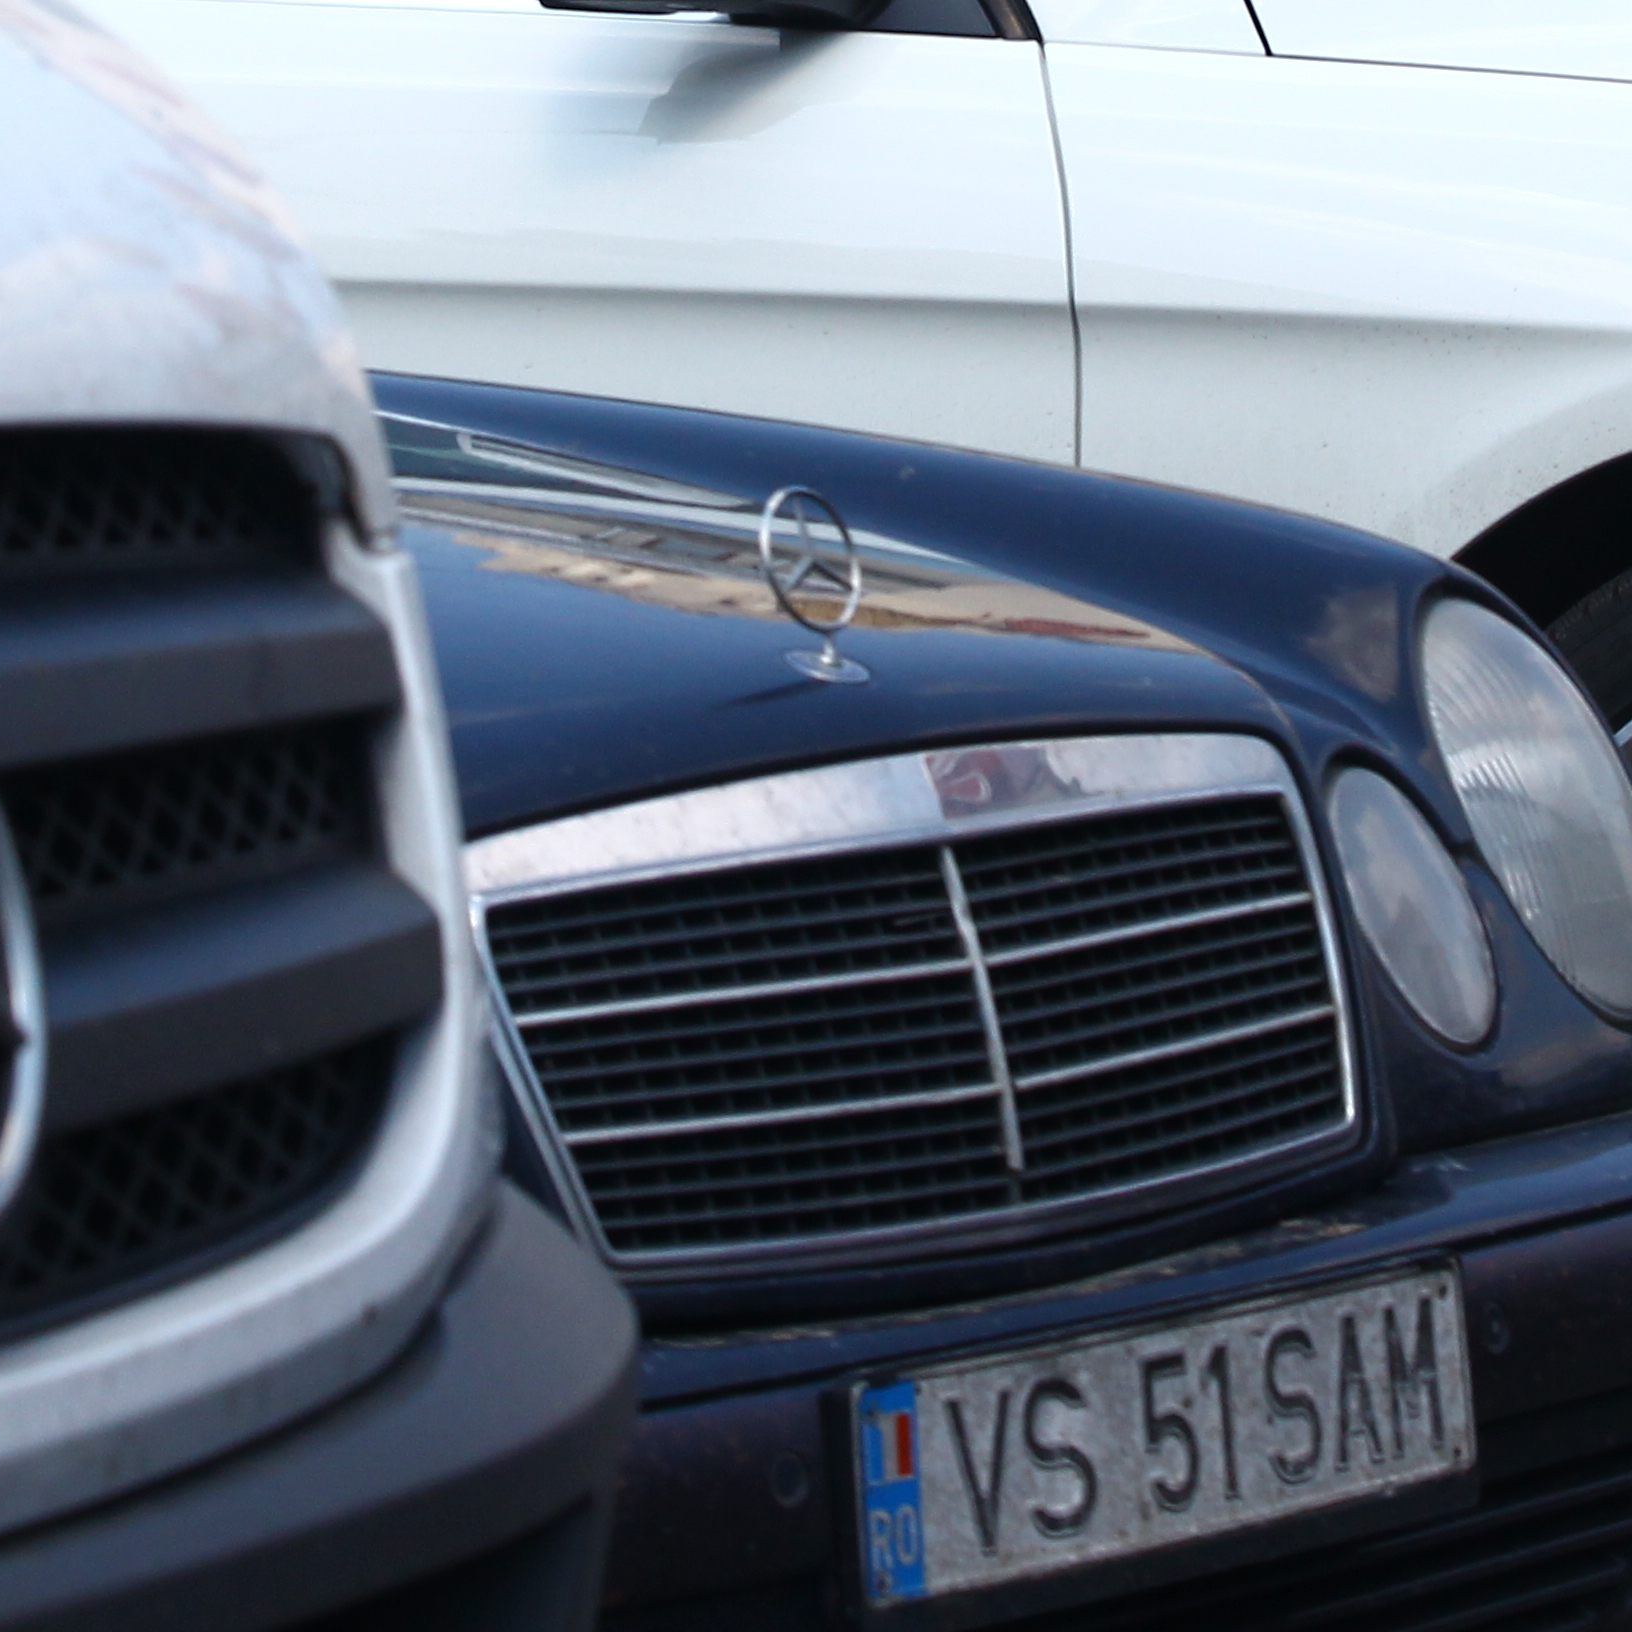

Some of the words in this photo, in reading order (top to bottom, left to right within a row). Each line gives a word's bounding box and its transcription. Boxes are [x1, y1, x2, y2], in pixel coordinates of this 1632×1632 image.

[946, 1379, 1097, 1557] VS
[1141, 1346, 1241, 1511] 51
[1269, 1295, 1448, 1486] SAM
[872, 1504, 920, 1567] RO
